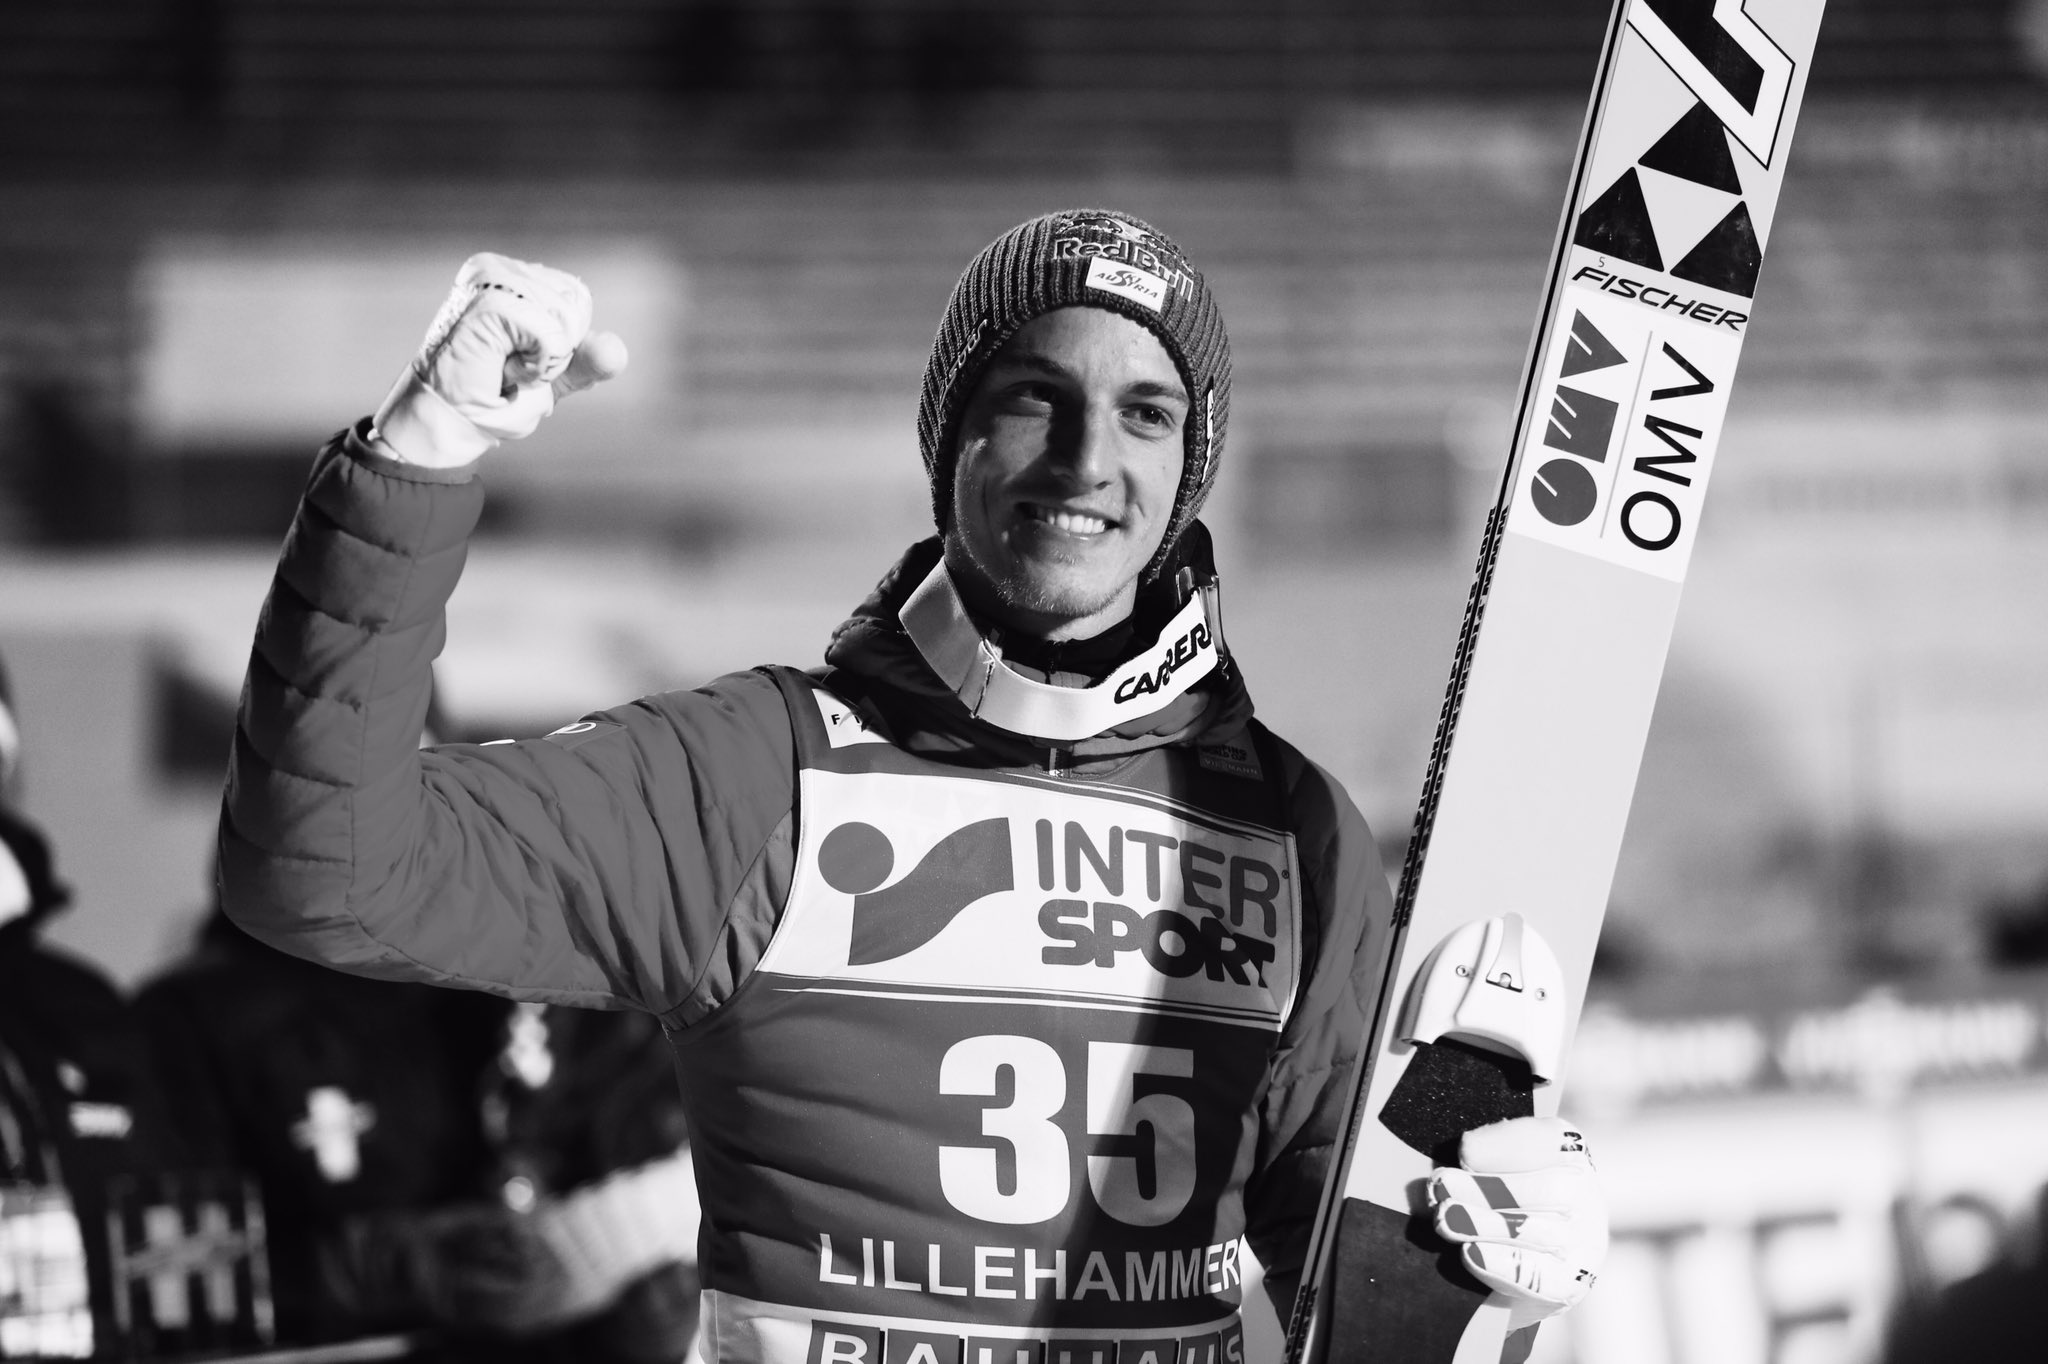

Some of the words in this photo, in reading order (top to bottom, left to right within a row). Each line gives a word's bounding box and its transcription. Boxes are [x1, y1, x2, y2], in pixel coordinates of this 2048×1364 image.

[1053, 237, 1130, 260] Red
[1133, 246, 1194, 302] Bull
[1571, 265, 1748, 331] FISCHER
[1620, 341, 1714, 551] OMV
[1114, 623, 1212, 704] CARRER
[1036, 819, 1280, 938] INTER
[1038, 898, 1275, 988] SPORT
[939, 1034, 1196, 1227] 35
[818, 1233, 1240, 1301] LILLEHAMMER
